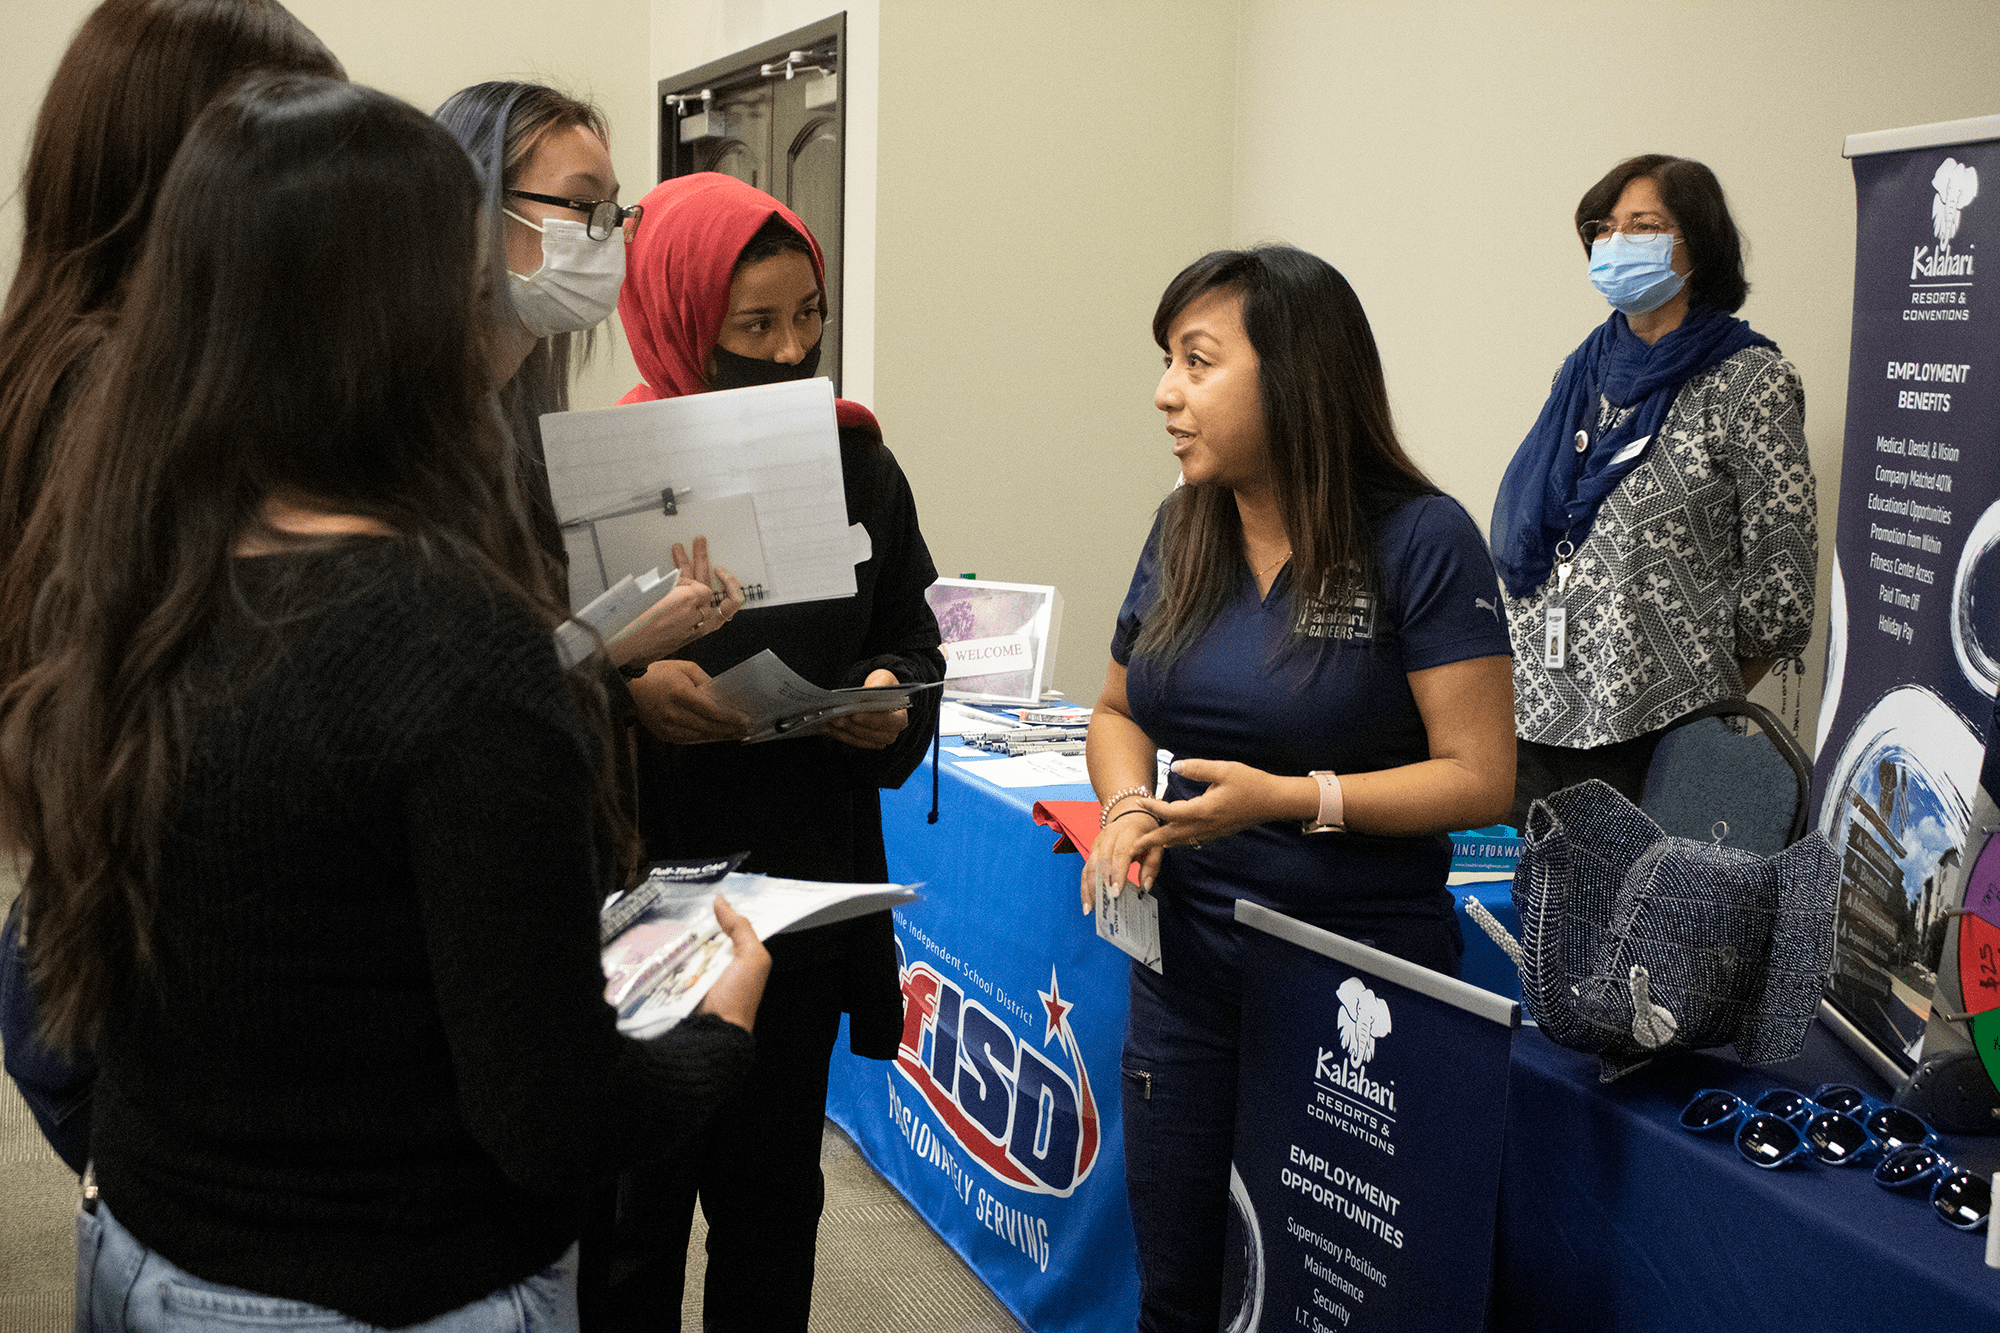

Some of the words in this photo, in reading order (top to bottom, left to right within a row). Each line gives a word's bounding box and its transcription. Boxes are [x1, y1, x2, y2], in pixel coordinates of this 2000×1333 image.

[1911, 244, 1974, 280] Kalahari
[1911, 292, 1956, 304] RESORTS
[1958, 292, 1967, 304] &
[1903, 309, 1970, 321] CONVENTIONS
[1887, 361, 1971, 383] EMPLOYMENT
[1898, 390, 1951, 412] BENEFITS
[1876, 436, 1906, 457] Medical,
[1908, 439, 1930, 460] Dental,
[1931, 441, 1937, 459] &
[1938, 443, 1960, 461] Vision
[1875, 465, 1909, 489] Company
[1909, 469, 1936, 490] Matched
[1868, 493, 1910, 516] Educational
[1909, 500, 1952, 525] Opportunities
[1870, 523, 1906, 547] Promotion
[1907, 529, 1921, 548] from
[1921, 535, 1942, 554] Within
[1870, 552, 1893, 574] Fitness
[1894, 557, 1915, 577] Center
[1915, 564, 1934, 585] Access
[1879, 584, 1894, 602] Paid
[1895, 588, 1910, 607] Time
[1910, 593, 1920, 611] Off
[1878, 614, 1902, 640] Holiday
[1902, 622, 1914, 645] Pay
[956, 644, 1023, 661] WELCOME
[909, 921, 961, 972] Independent
[963, 959, 993, 994] School
[996, 988, 1034, 1027] District
[1314, 1046, 1395, 1111] Kalahari
[1307, 1104, 1395, 1156] CONVENTIONS
[1317, 1091, 1378, 1128] RESORTS
[1381, 1123, 1390, 1137] &
[1290, 1144, 1400, 1216] EMPLOYMENT
[1281, 1167, 1403, 1249] OPPORTUNITIES
[976, 1187, 1049, 1273] SERVING
[1287, 1216, 1344, 1262] Supervisory
[1345, 1248, 1387, 1288] Positions
[1304, 1254, 1364, 1303] Maintenance
[1295, 1306, 1309, 1328] I.T.
[1312, 1287, 1350, 1327] Security
